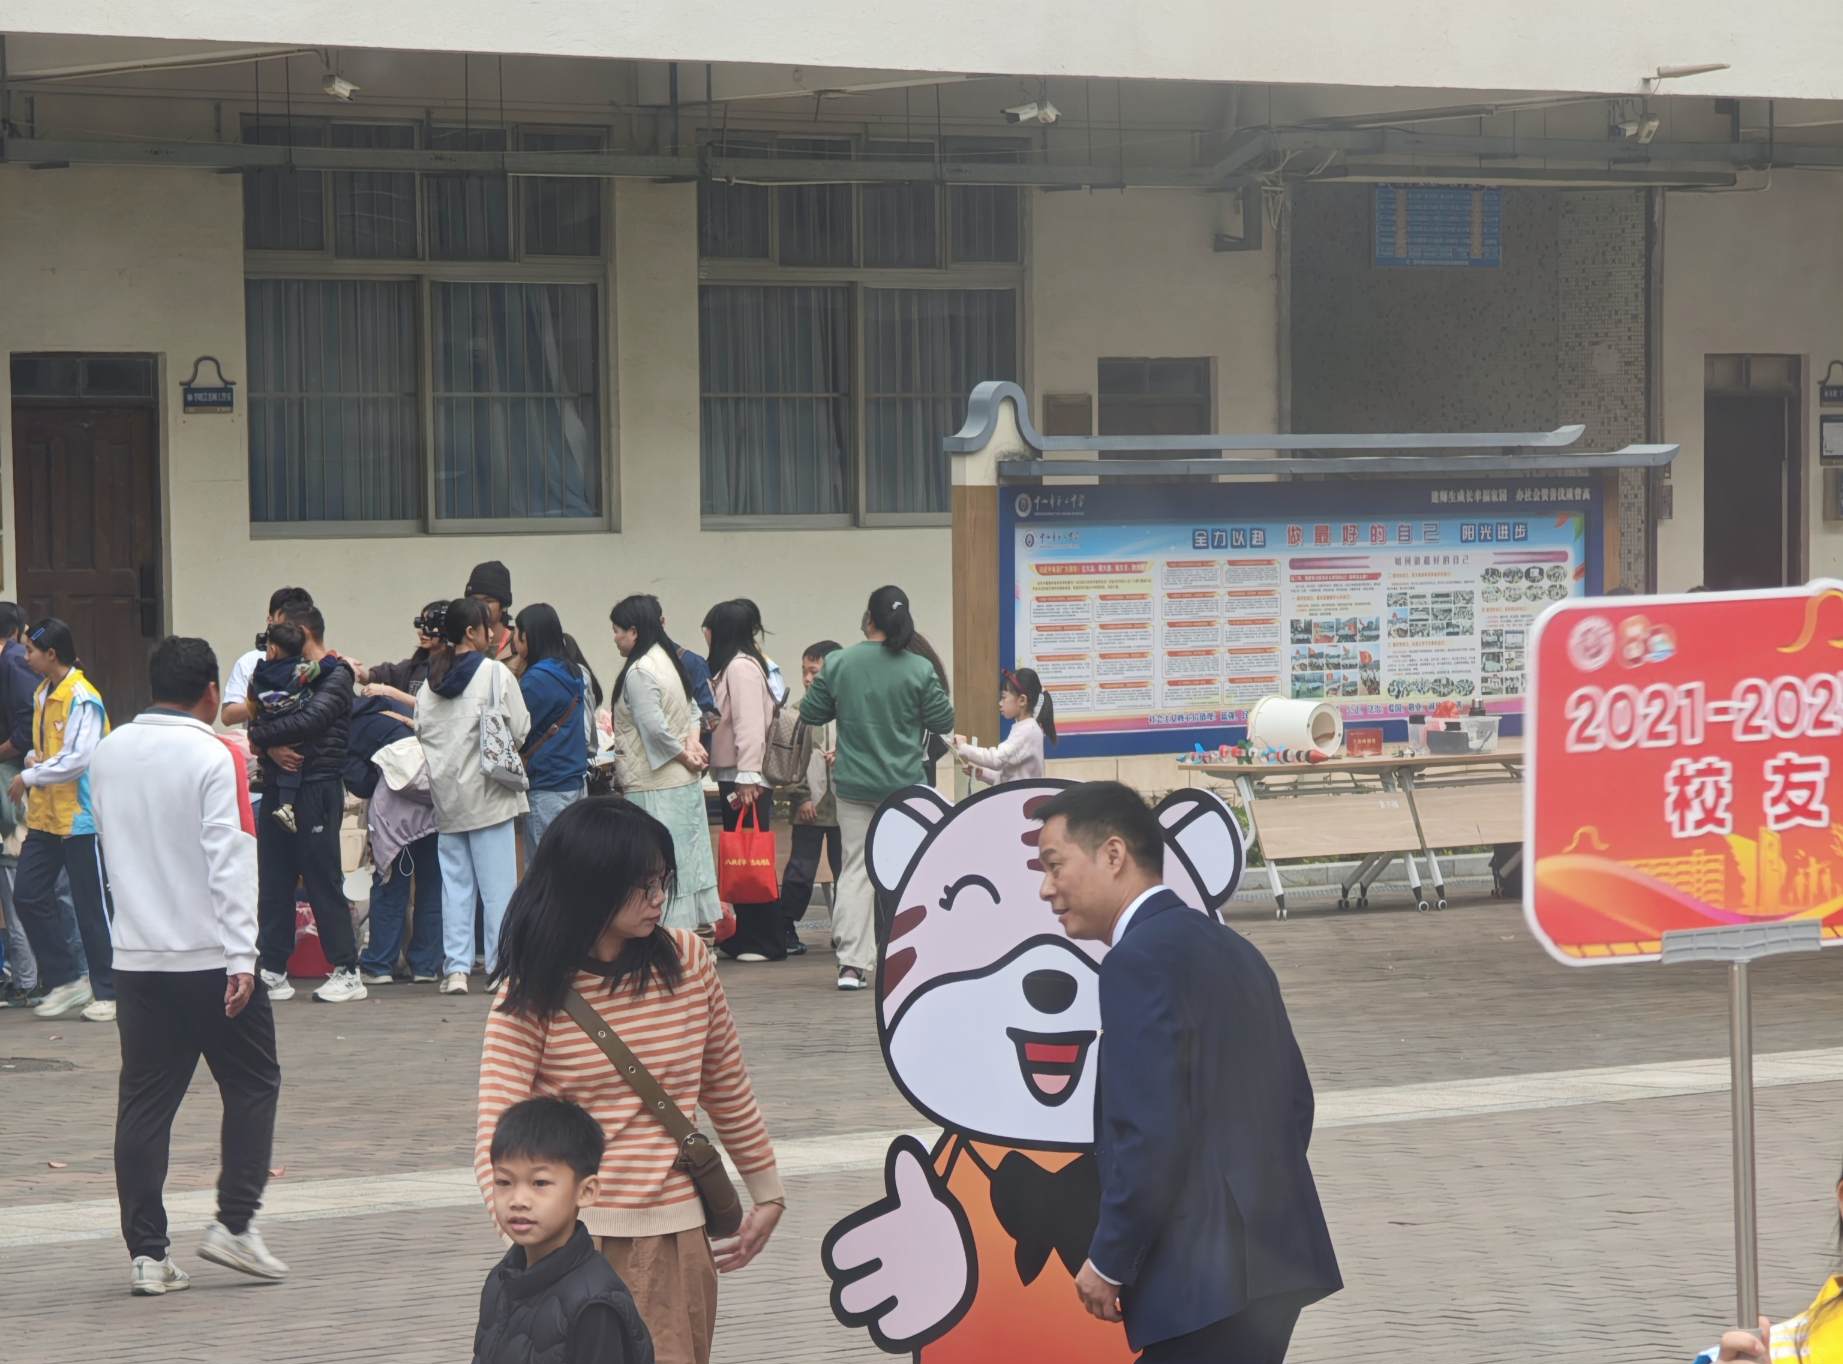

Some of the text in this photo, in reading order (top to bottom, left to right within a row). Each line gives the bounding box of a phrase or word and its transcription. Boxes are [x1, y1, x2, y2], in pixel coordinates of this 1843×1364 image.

[1193, 522, 1529, 549] 全力以赴 做最好的自己 阳光进步
[1565, 670, 1843, 753] 2021-202
[1664, 752, 1830, 839] 校友
